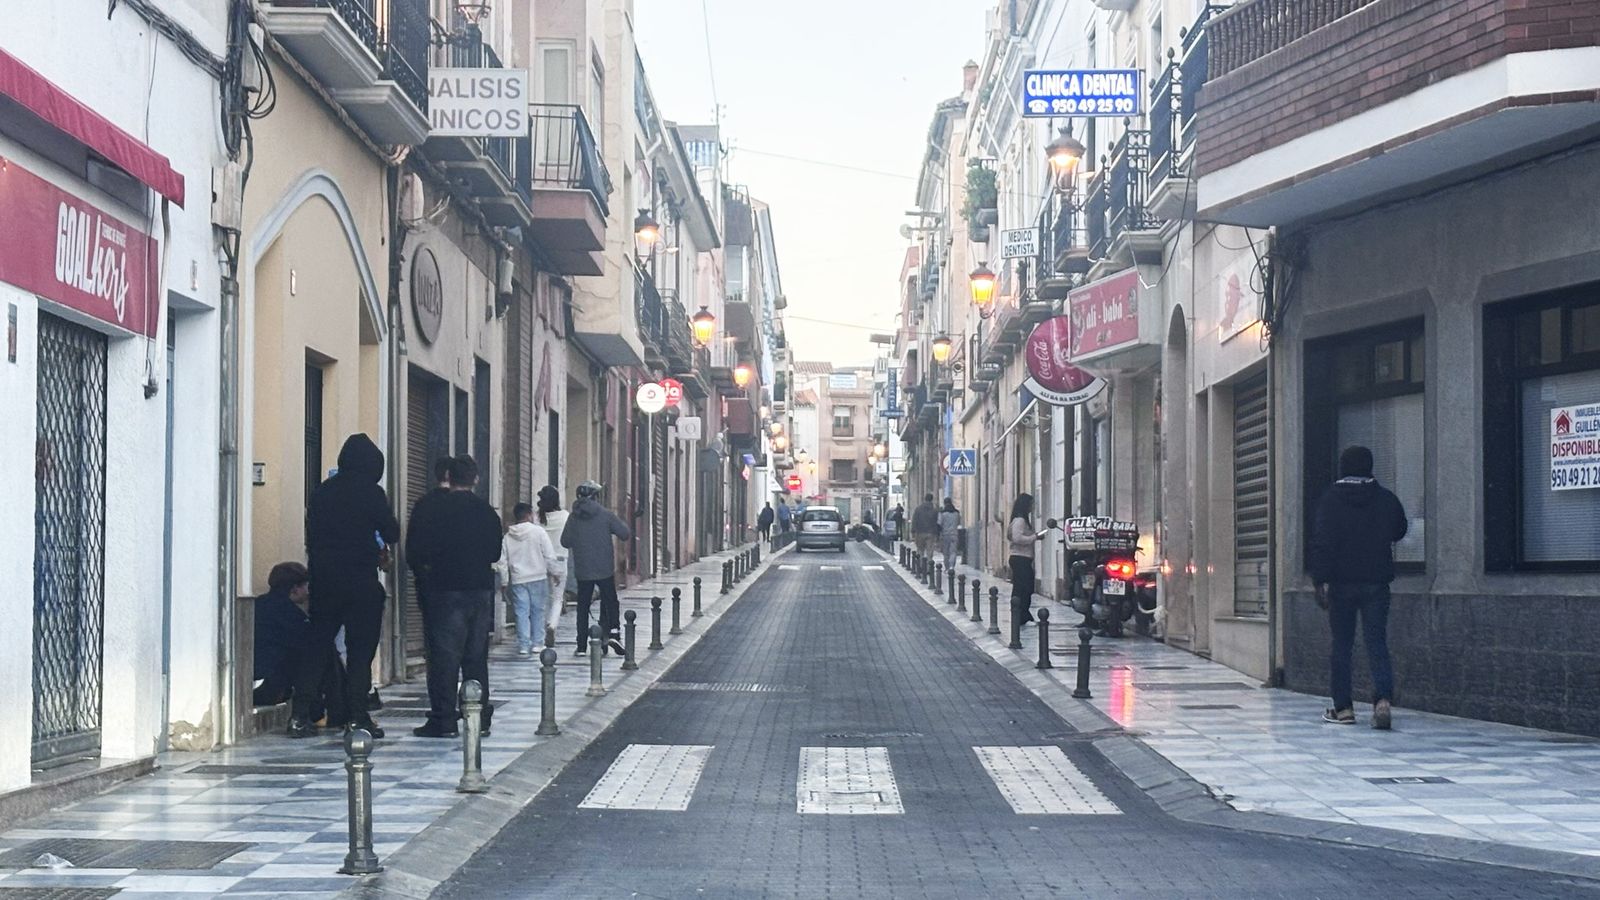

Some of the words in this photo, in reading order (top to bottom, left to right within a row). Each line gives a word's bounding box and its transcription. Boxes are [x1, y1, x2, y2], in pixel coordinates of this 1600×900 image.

[1027, 74, 1080, 97] CLINICA
[1082, 73, 1135, 96] DENTAL
[1051, 98, 1077, 113] 950
[1078, 98, 1096, 113] 49
[1097, 98, 1114, 113] 25
[1114, 97, 1134, 113] 90
[432, 108, 521, 130] INICOS
[1004, 243, 1035, 257] DENTISTA
[1551, 468, 1567, 487] 950
[1568, 467, 1579, 486] 49
[1580, 466, 1590, 485] 21
[1592, 465, 1600, 485] 2
[1097, 521, 1112, 530] ALI
[1113, 522, 1136, 531] BABA
